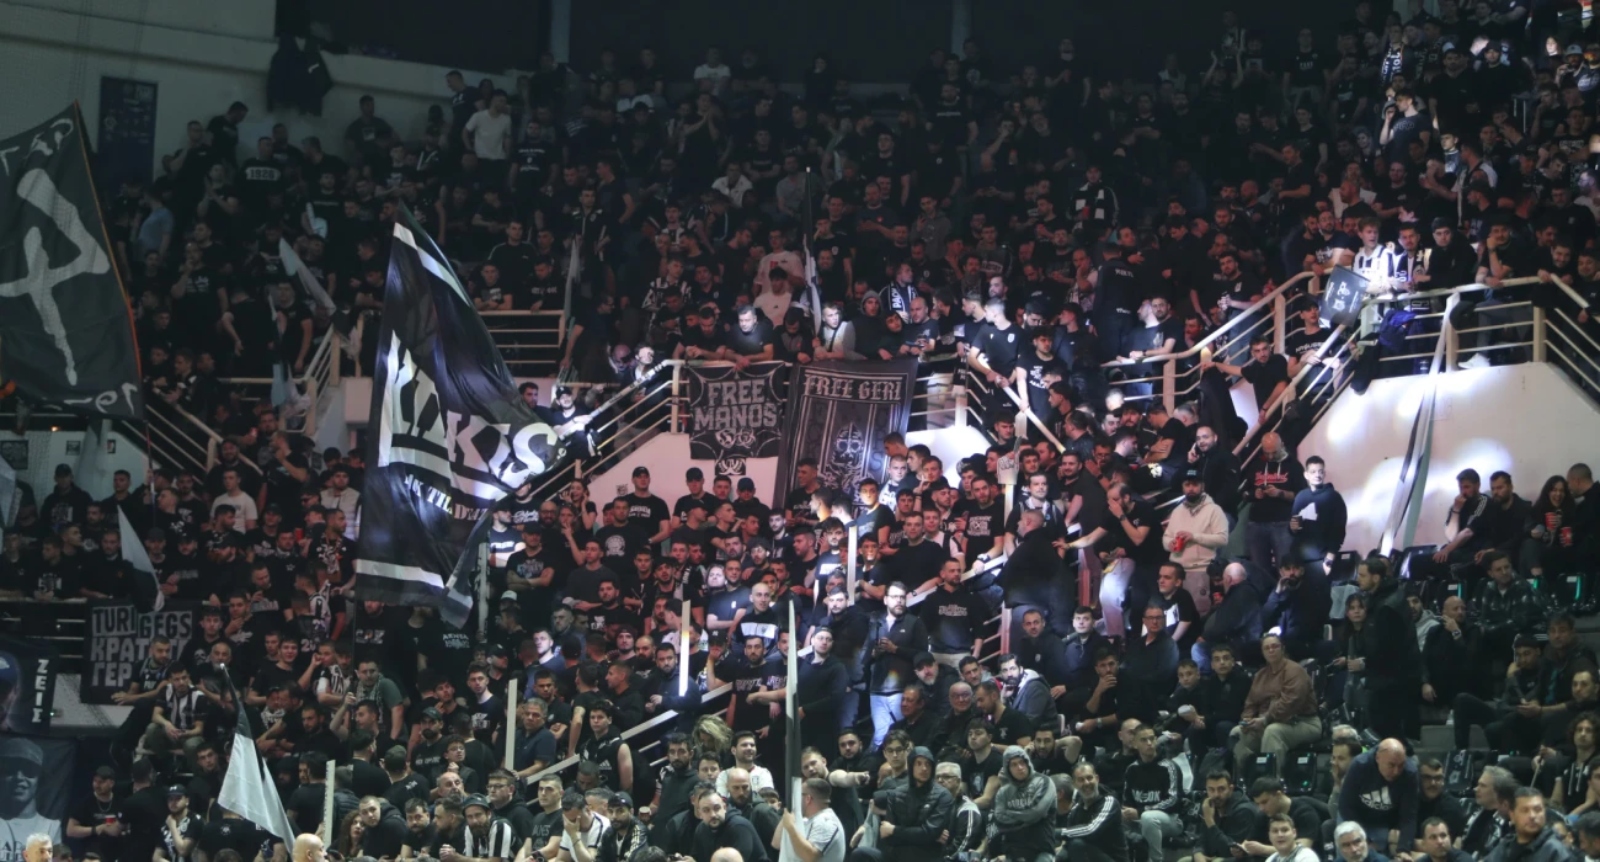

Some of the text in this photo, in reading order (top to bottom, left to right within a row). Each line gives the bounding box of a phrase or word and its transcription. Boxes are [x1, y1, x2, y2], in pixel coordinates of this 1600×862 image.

[707, 378, 765, 405] FREE
[803, 373, 902, 401] FREE GERI
[693, 400, 778, 434] MANOS
[140, 612, 192, 639] GEGS
[32, 658, 49, 723] ΖΕΙΣ
